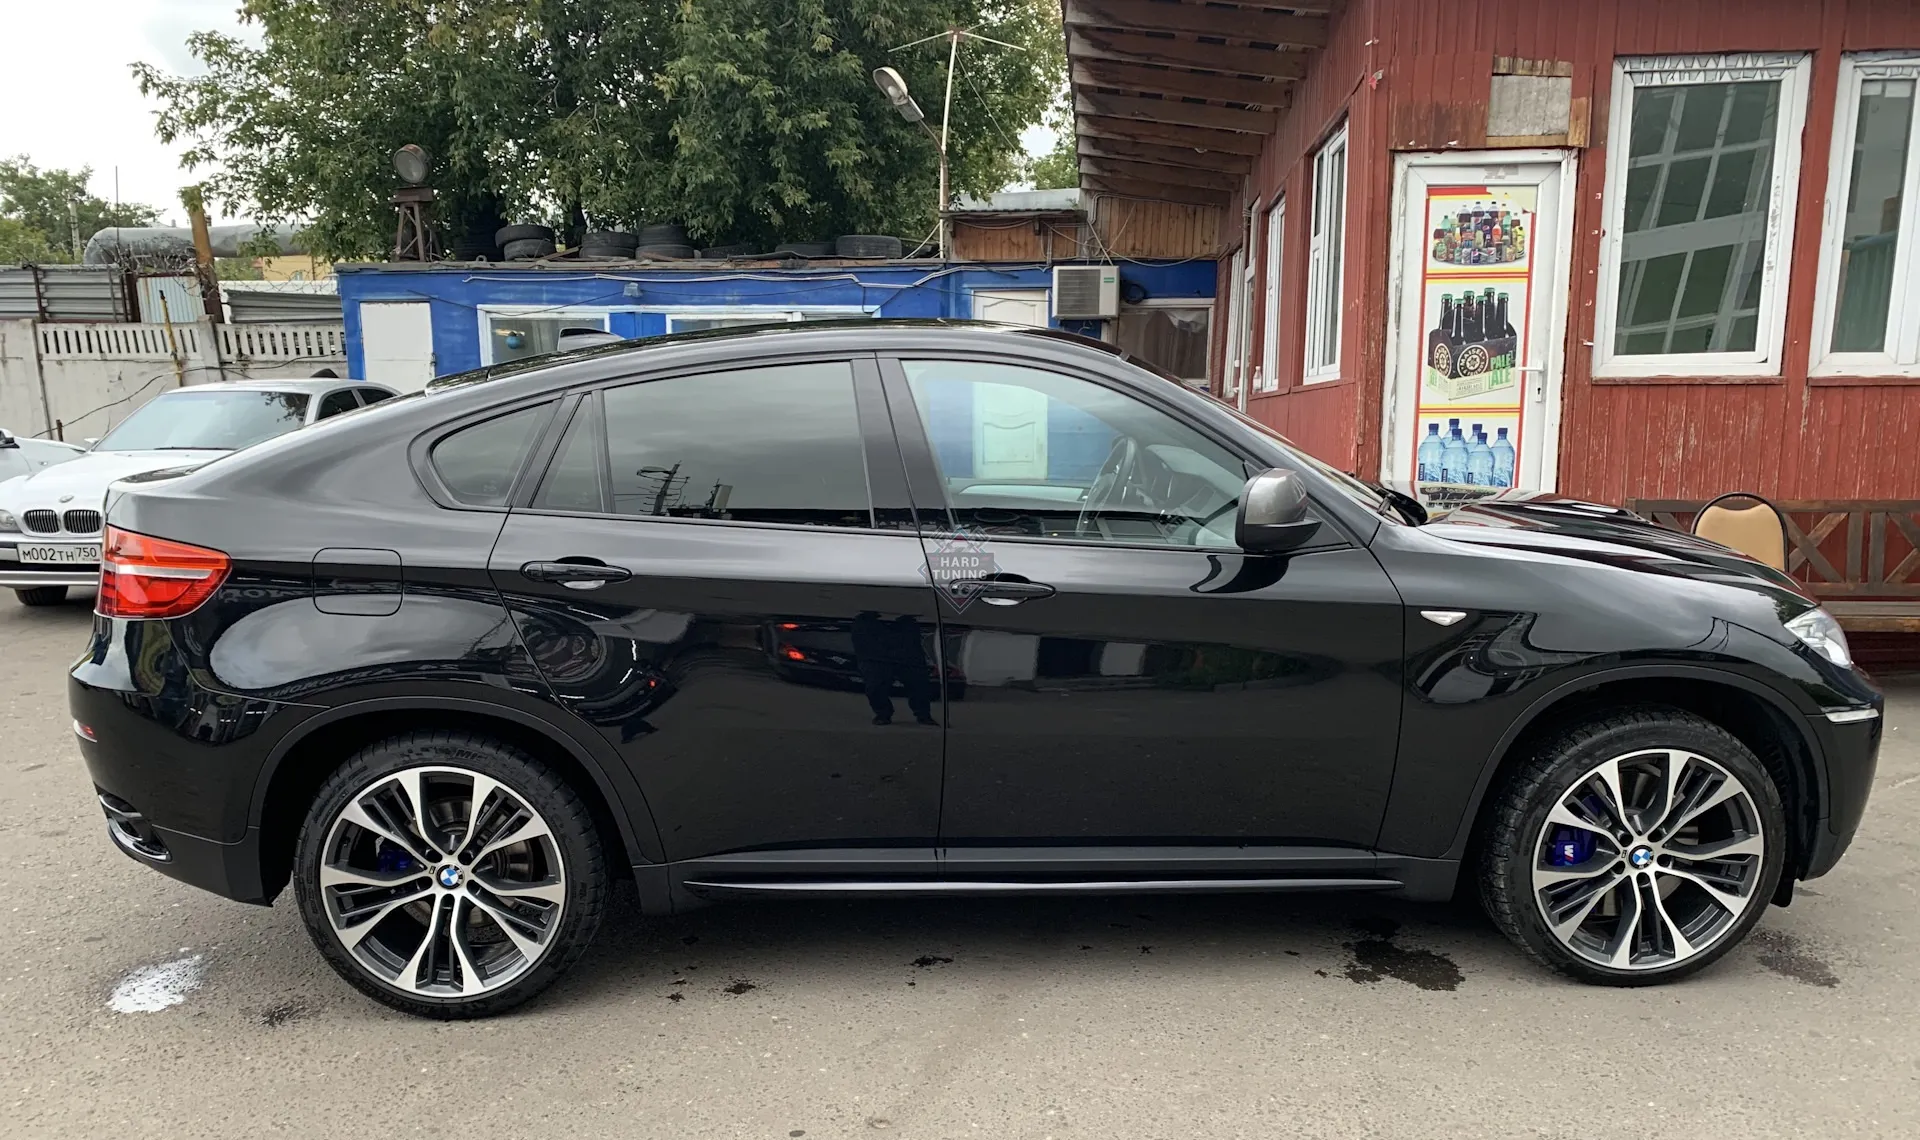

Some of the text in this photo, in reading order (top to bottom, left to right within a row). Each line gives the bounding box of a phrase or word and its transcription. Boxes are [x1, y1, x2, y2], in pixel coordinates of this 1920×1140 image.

[1490, 353, 1511, 371] PALE
[1490, 366, 1511, 387] ALE
[22, 547, 97, 561] М002ТН 750
